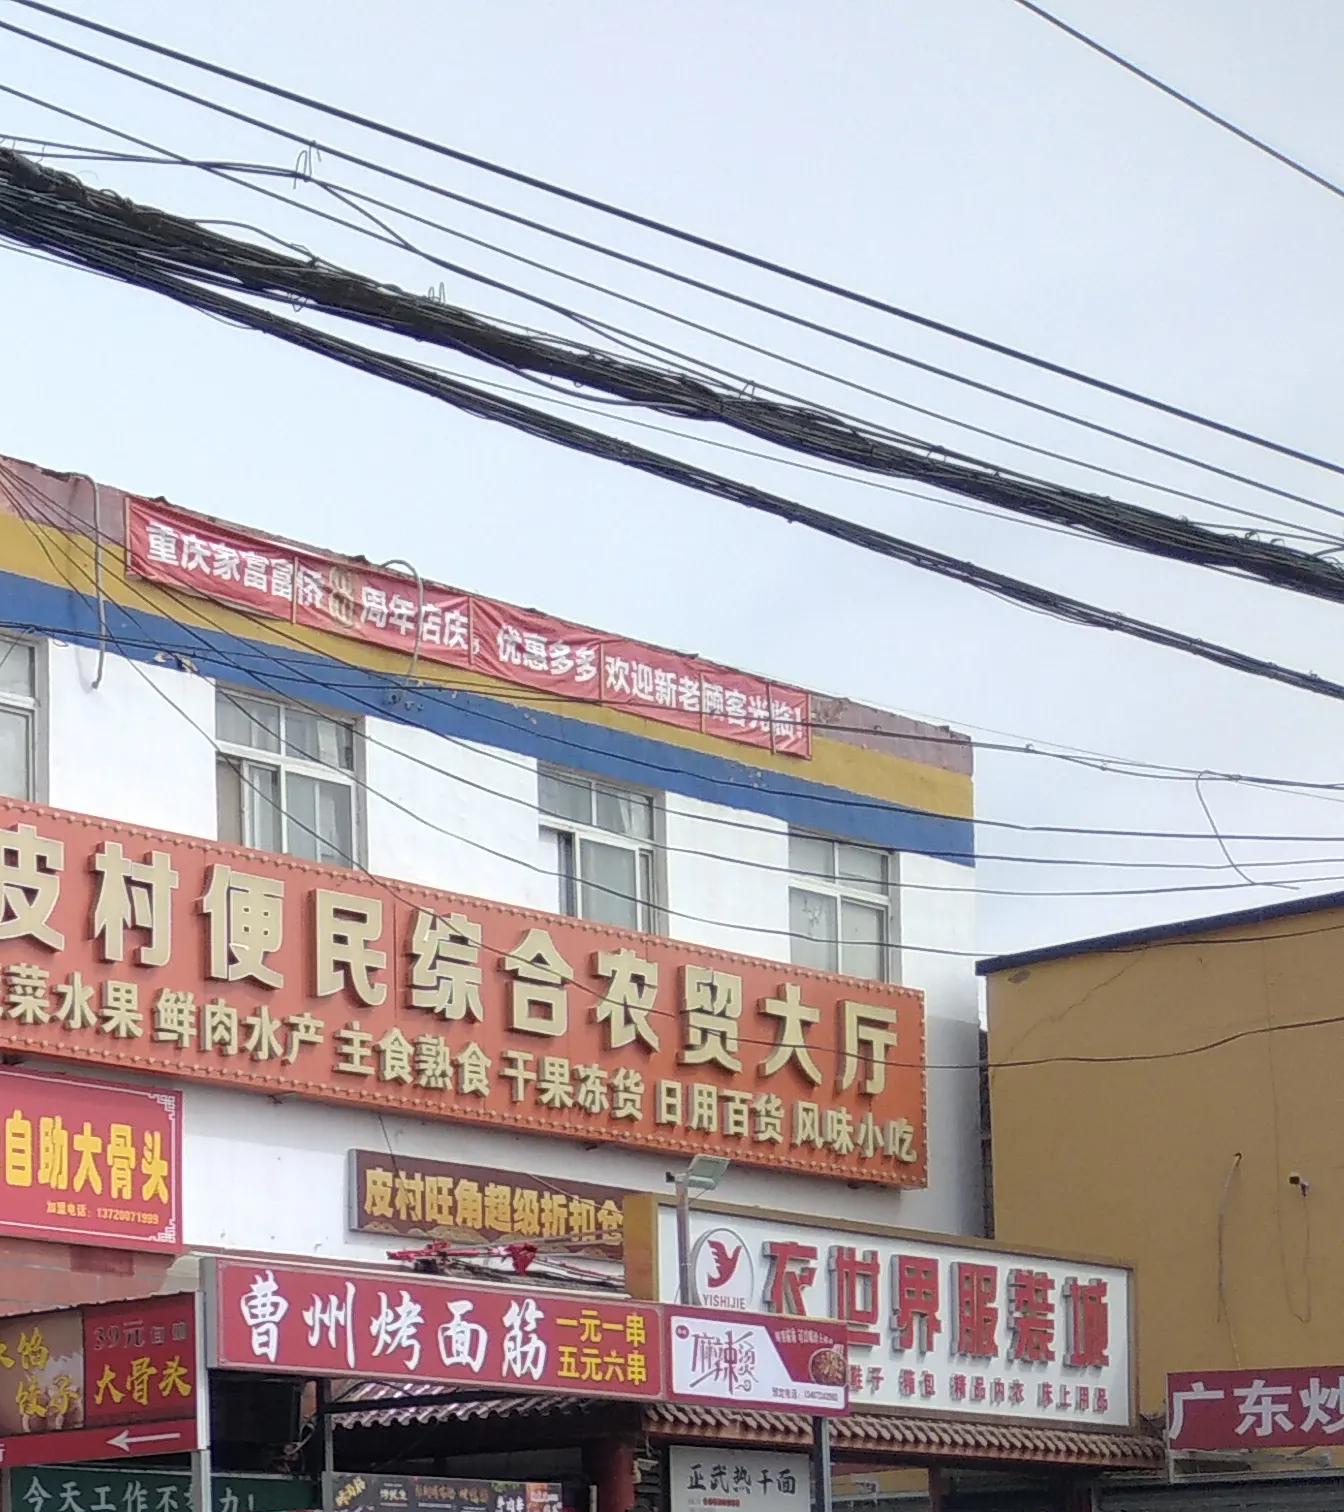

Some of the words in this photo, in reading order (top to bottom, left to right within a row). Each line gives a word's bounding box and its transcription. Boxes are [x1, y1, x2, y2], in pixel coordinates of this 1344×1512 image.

[154, 987, 324, 1064] 鲜肉水产
[335, 1021, 490, 1097] 主食熟食
[501, 1056, 644, 1123] 干果冻货
[654, 1079, 784, 1145] 日用百货
[793, 1099, 917, 1163] 风味小吃
[364, 1167, 624, 1245] 皮村旺角超级折扣仓
[240, 1270, 549, 1381] 曹州烤面筋
[702, 1294, 746, 1310] YISHIJIE
[763, 1240, 1110, 1369] 衣世界服装城
[556, 1309, 648, 1348] 一元一串
[94, 1355, 193, 1406] 大骨头
[556, 1344, 648, 1386] 五元六串
[689, 1329, 759, 1395] 麻辣烫
[15, 1372, 81, 1418] 饺子
[951, 1374, 1024, 1405] 精品内衣
[1039, 1381, 1109, 1413] 床上用品
[1168, 1376, 1344, 1440] 广东炒
[687, 1464, 797, 1495] 正武热干面
